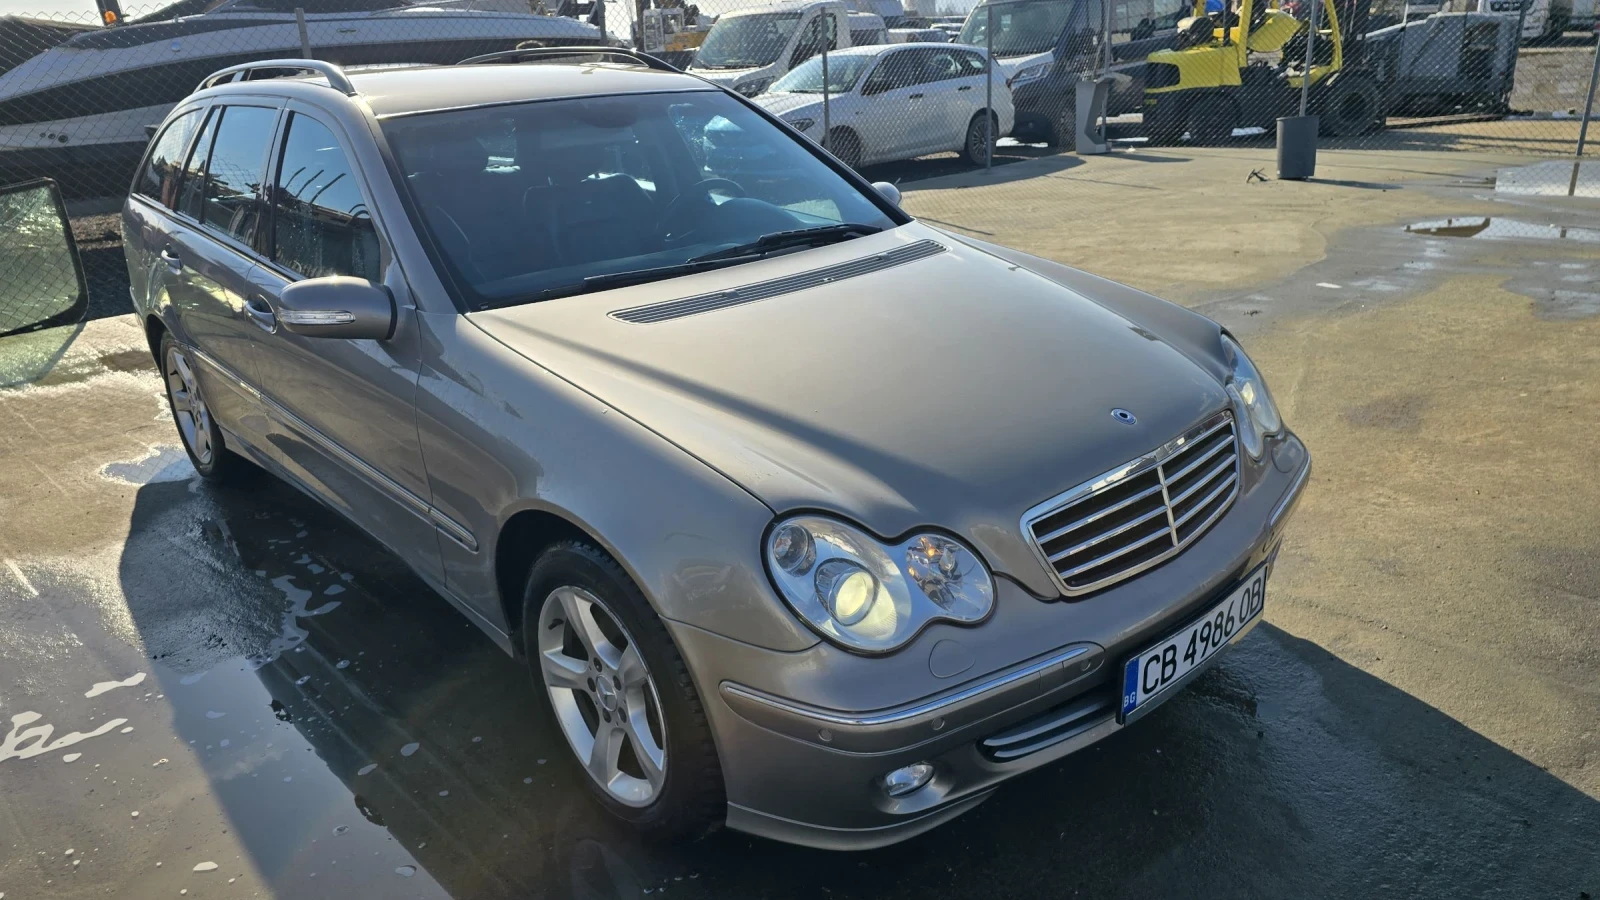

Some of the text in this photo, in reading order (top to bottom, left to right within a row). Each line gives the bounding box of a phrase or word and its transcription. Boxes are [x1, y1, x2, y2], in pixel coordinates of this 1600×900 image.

[1143, 578, 1261, 694] CB 4986 OB
[1124, 692, 1136, 707] BG
